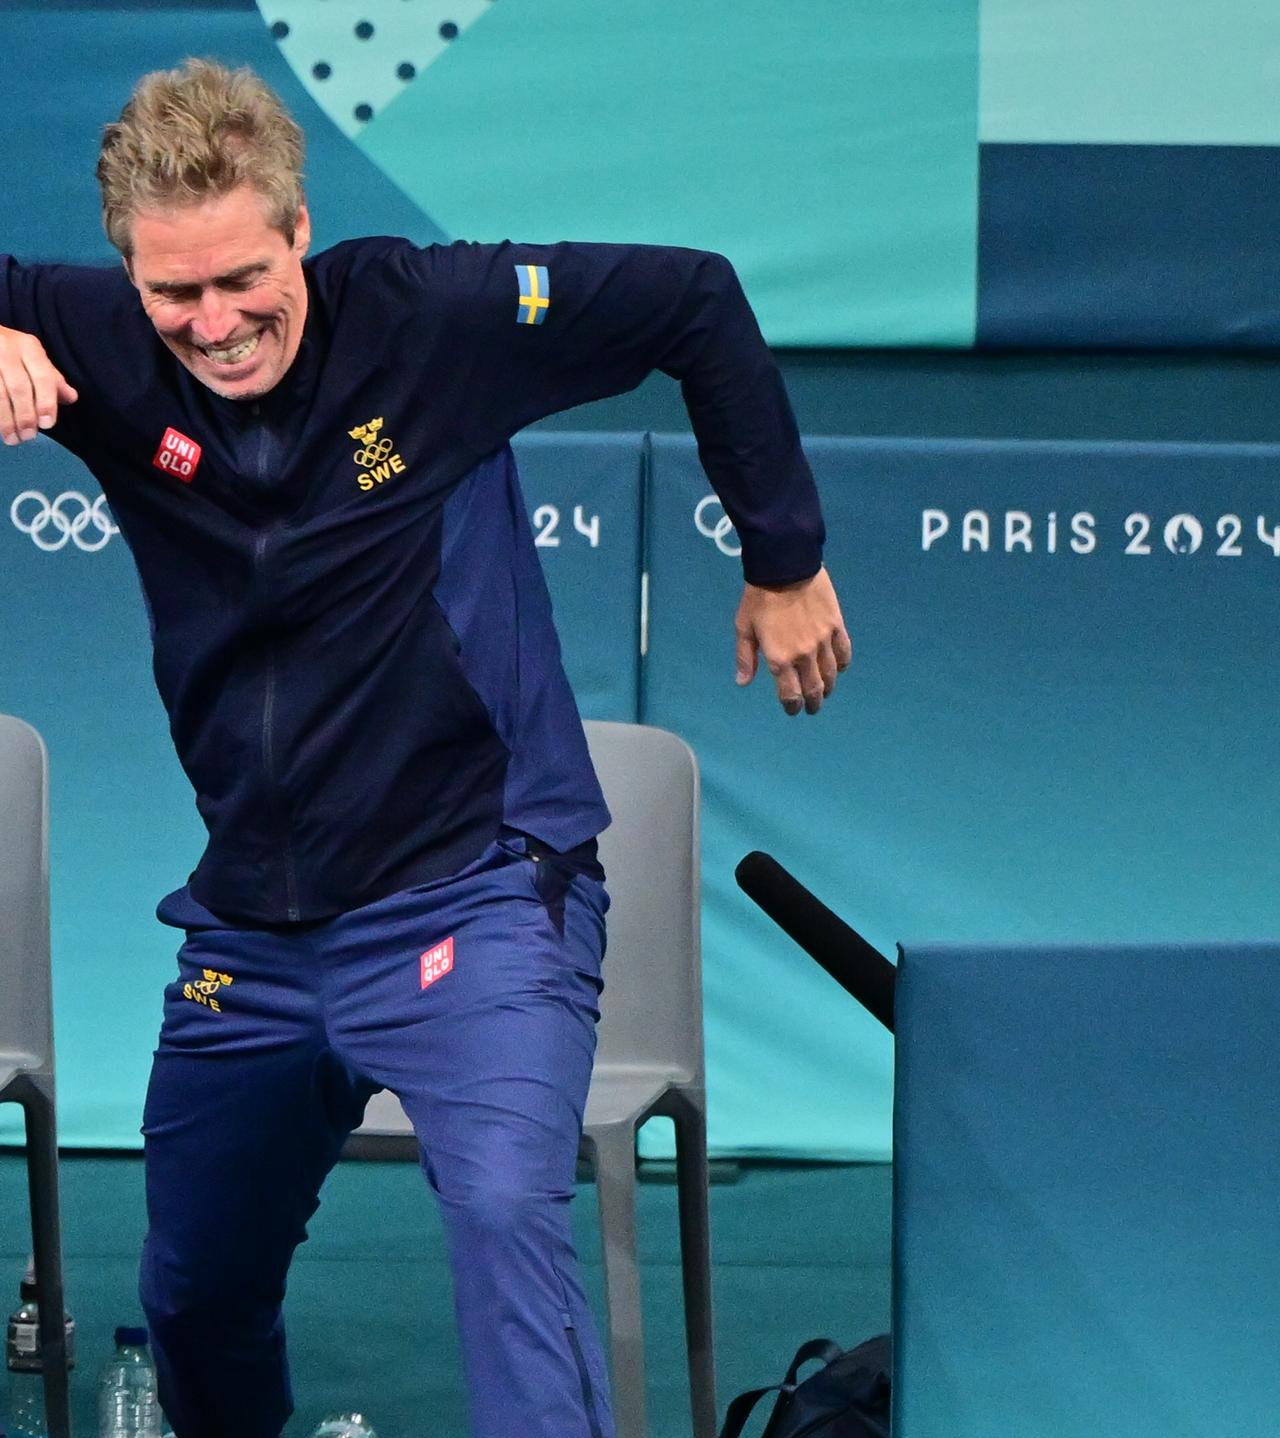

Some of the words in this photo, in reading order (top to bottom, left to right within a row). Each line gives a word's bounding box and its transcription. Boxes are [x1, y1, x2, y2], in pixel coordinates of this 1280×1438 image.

[166, 433, 197, 460] UNI
[159, 450, 192, 477] QLO
[357, 454, 407, 491] SWE
[423, 945, 448, 967] UNI
[423, 959, 450, 982] QLO
[183, 983, 222, 1013] SWE
